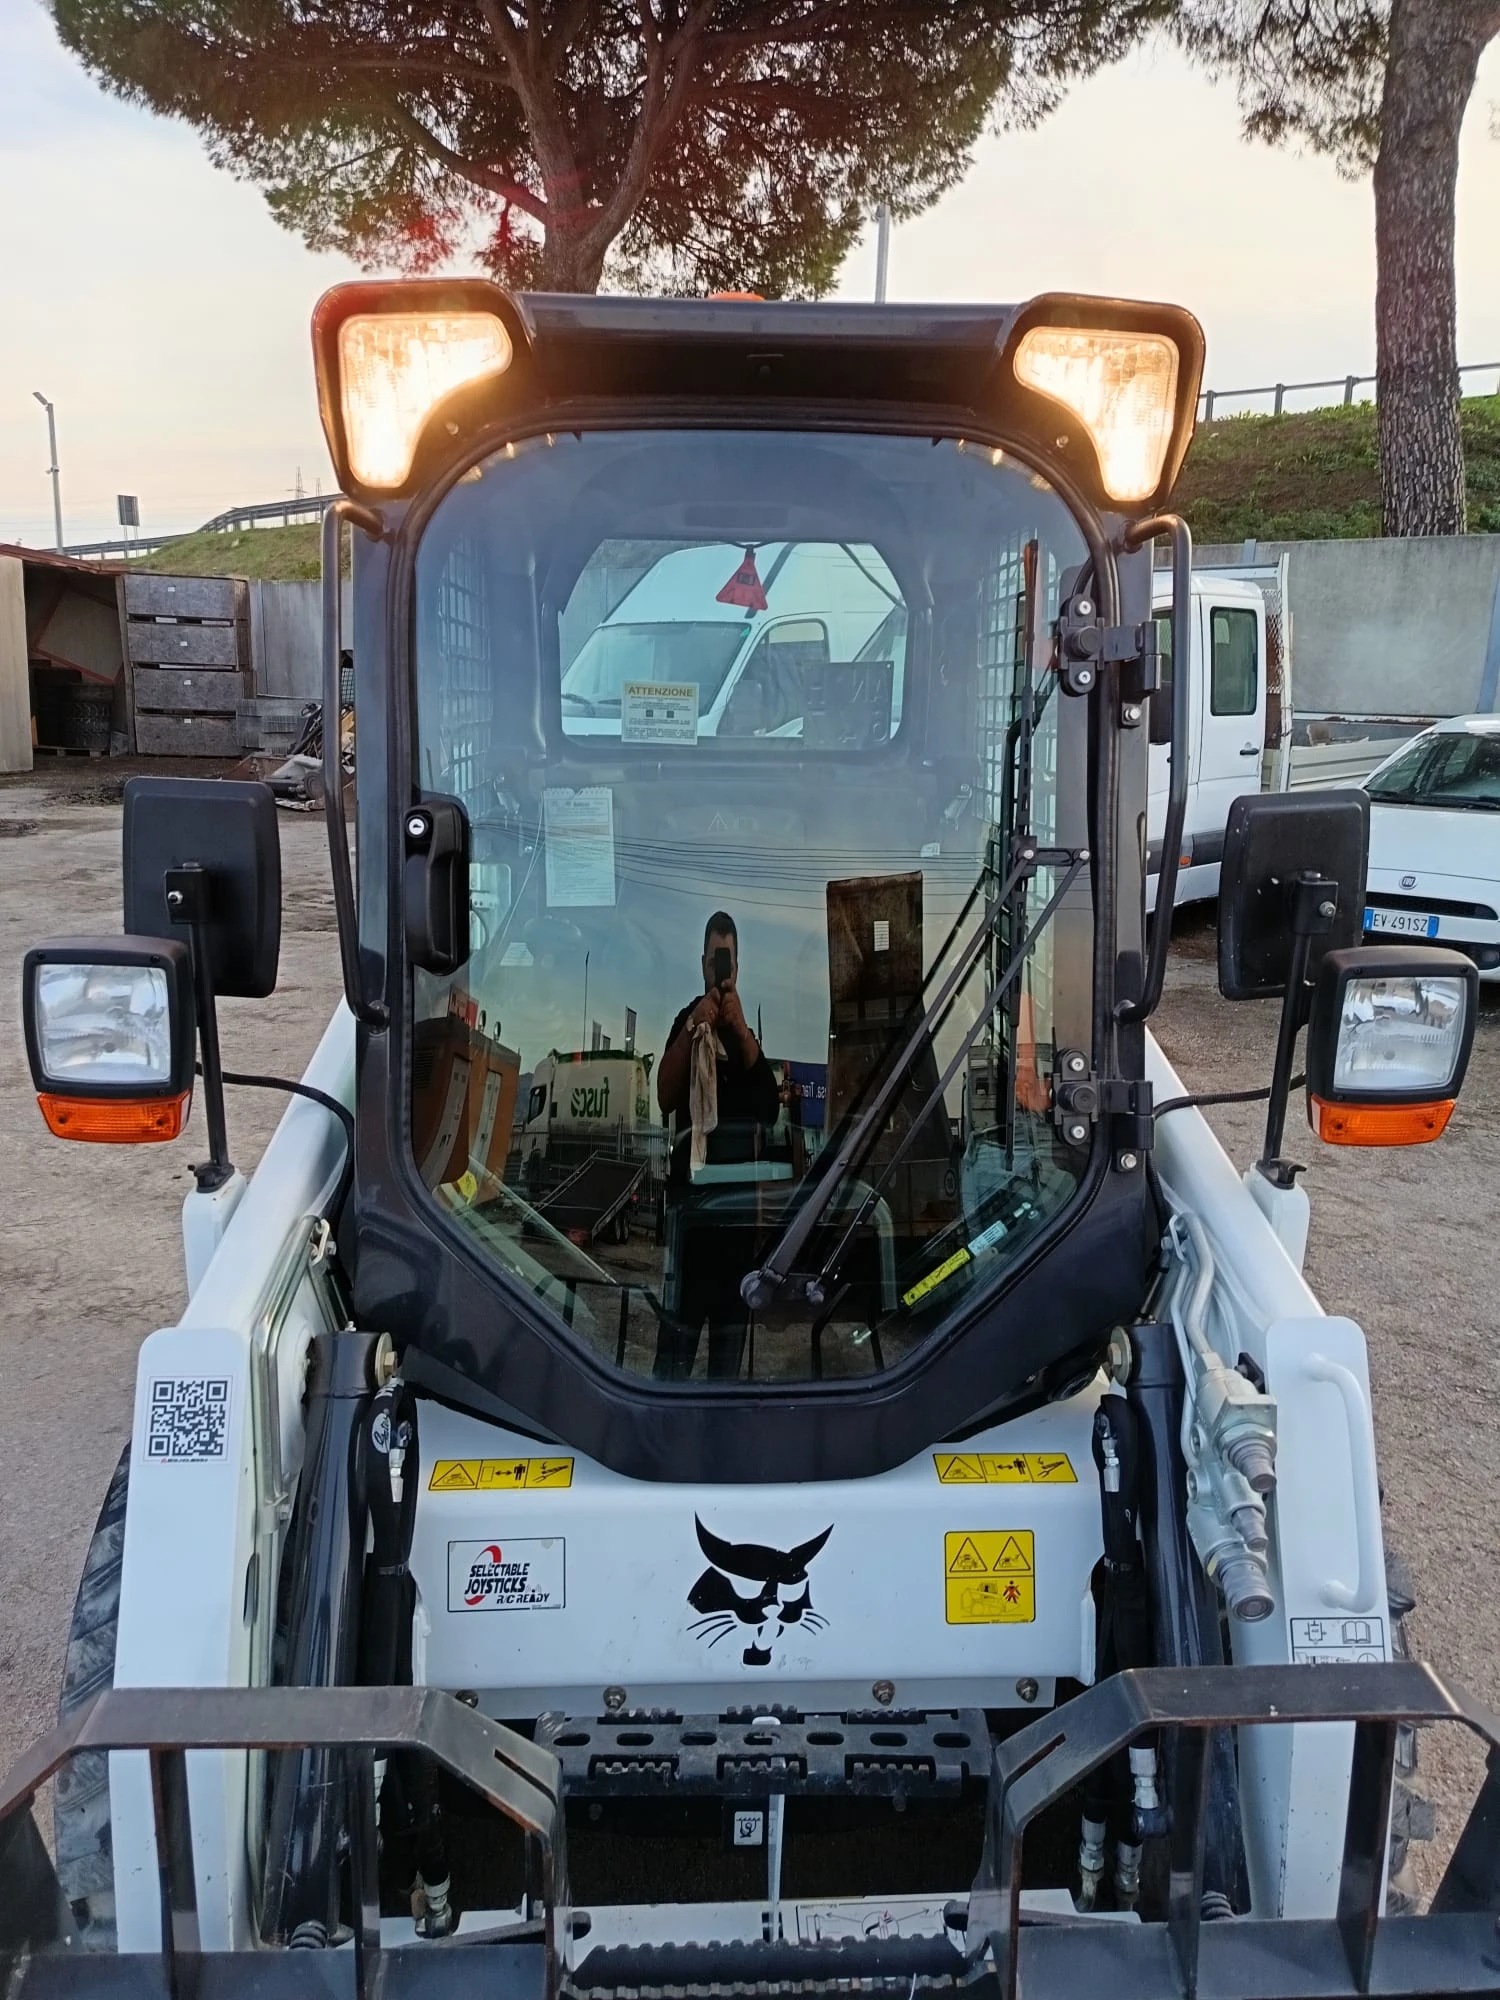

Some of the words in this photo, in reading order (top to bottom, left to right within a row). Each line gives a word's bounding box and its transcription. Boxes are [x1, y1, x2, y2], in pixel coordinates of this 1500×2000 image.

[628, 686, 693, 697] ATTENZIONE
[1373, 913, 1387, 928] EV
[1391, 916, 1428, 933] 491SZ
[469, 1563, 530, 1577] SELECTABLE
[464, 1577, 527, 1595] JOYSTICKS
[516, 1592, 550, 1603] READY
